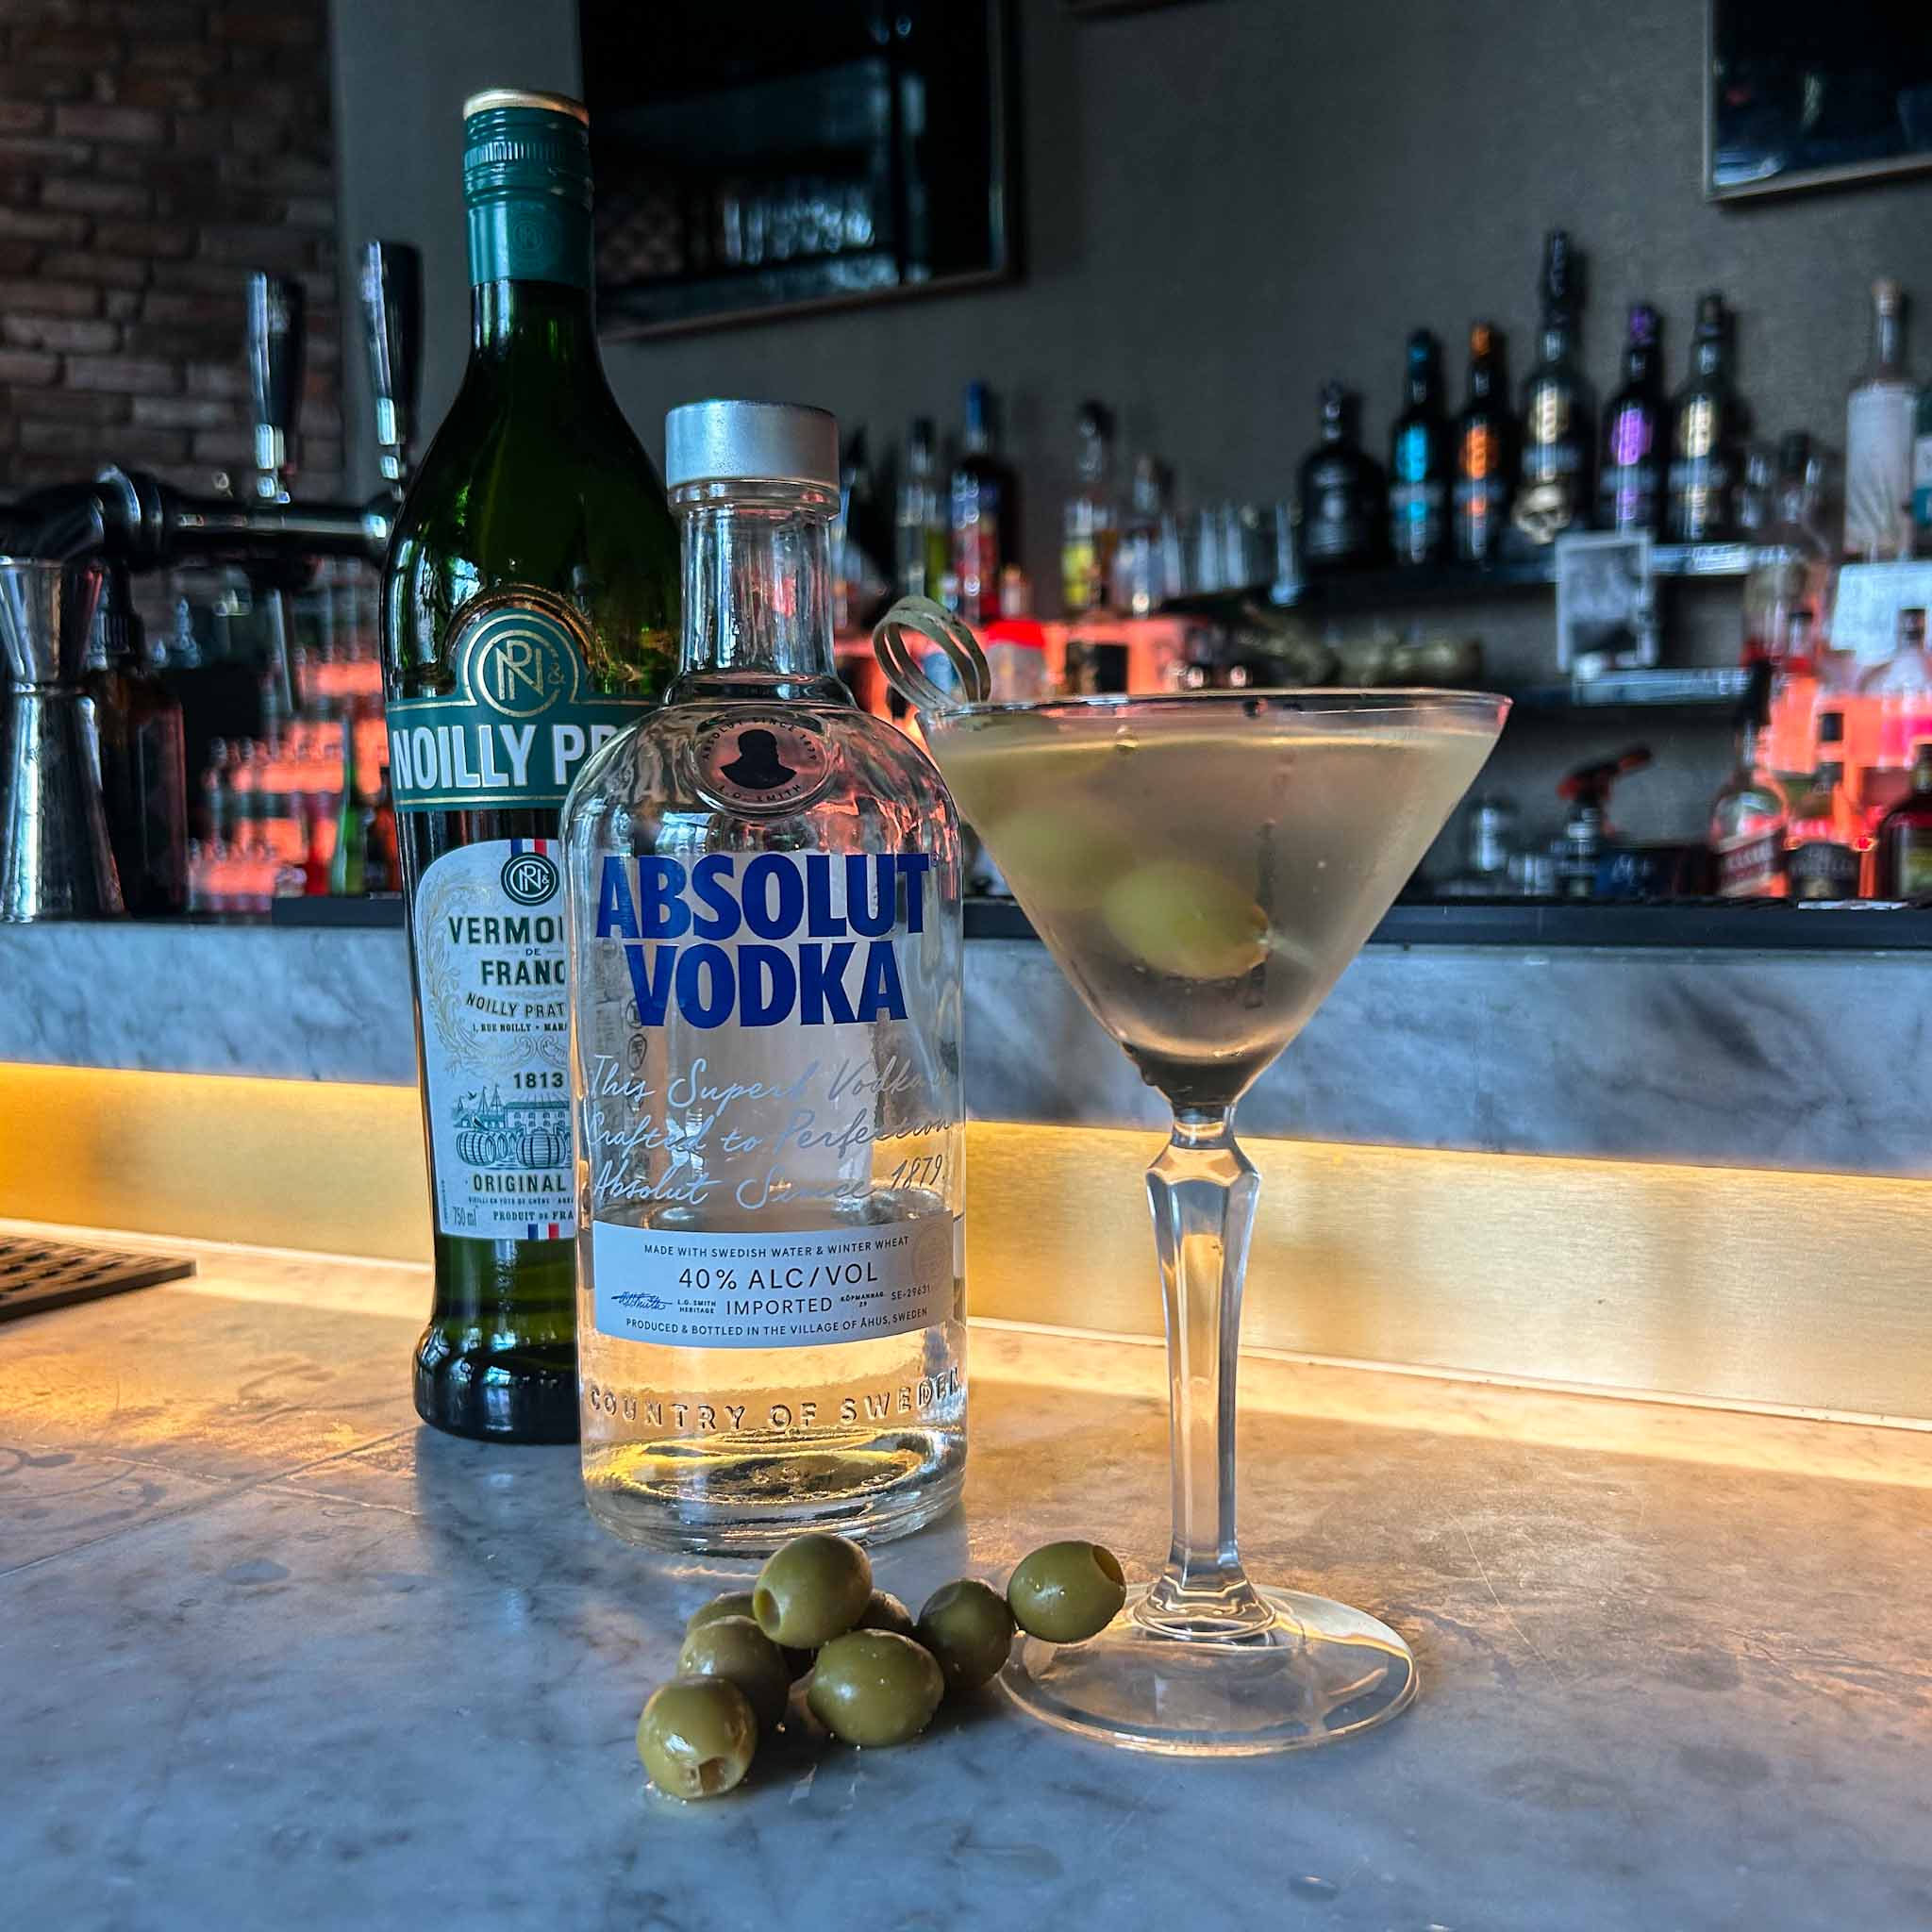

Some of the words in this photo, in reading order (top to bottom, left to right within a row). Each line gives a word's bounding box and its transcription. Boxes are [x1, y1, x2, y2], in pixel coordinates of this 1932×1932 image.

[392, 724, 537, 791] NOILLY
[596, 853, 929, 941] ABSOLUT
[448, 916, 563, 944] VERMO
[525, 948, 541, 957] DE
[625, 941, 908, 1029] VODKA
[466, 991, 518, 1018] NOILLY
[525, 1002, 566, 1018] PRAT
[513, 1072, 564, 1089] 1813
[591, 1054, 656, 1103] This
[721, 1125, 763, 1152] to
[474, 1174, 566, 1192] ORIGINAL
[593, 1159, 723, 1205] Absolut
[453, 1207, 466, 1226] 750
[493, 1210, 536, 1222] PRODUIT
[644, 1244, 674, 1256] MADE
[677, 1247, 708, 1257] WITH
[711, 1248, 766, 1258] SWEDISH
[772, 1246, 812, 1257] WATER
[817, 1245, 824, 1256] &
[828, 1241, 871, 1255] WINTER
[875, 1236, 909, 1251] WHEAT
[679, 1268, 738, 1290] 40%
[748, 1261, 878, 1290] ALC/VOL
[693, 1299, 717, 1307] SMITH
[726, 1296, 832, 1316] IMPORTED
[626, 1318, 678, 1334] PRODUCED
[681, 1325, 689, 1335] &
[691, 1325, 743, 1337] BOTTLED
[747, 1326, 759, 1336] IN
[763, 1325, 786, 1336] THE
[791, 1322, 839, 1335] VILLAGE
[842, 1321, 858, 1331] OF
[892, 1307, 927, 1324] SWEDEN
[590, 1385, 745, 1431] COUNTRY
[770, 1402, 817, 1428] OF
[839, 1367, 960, 1425] SWEDEN
